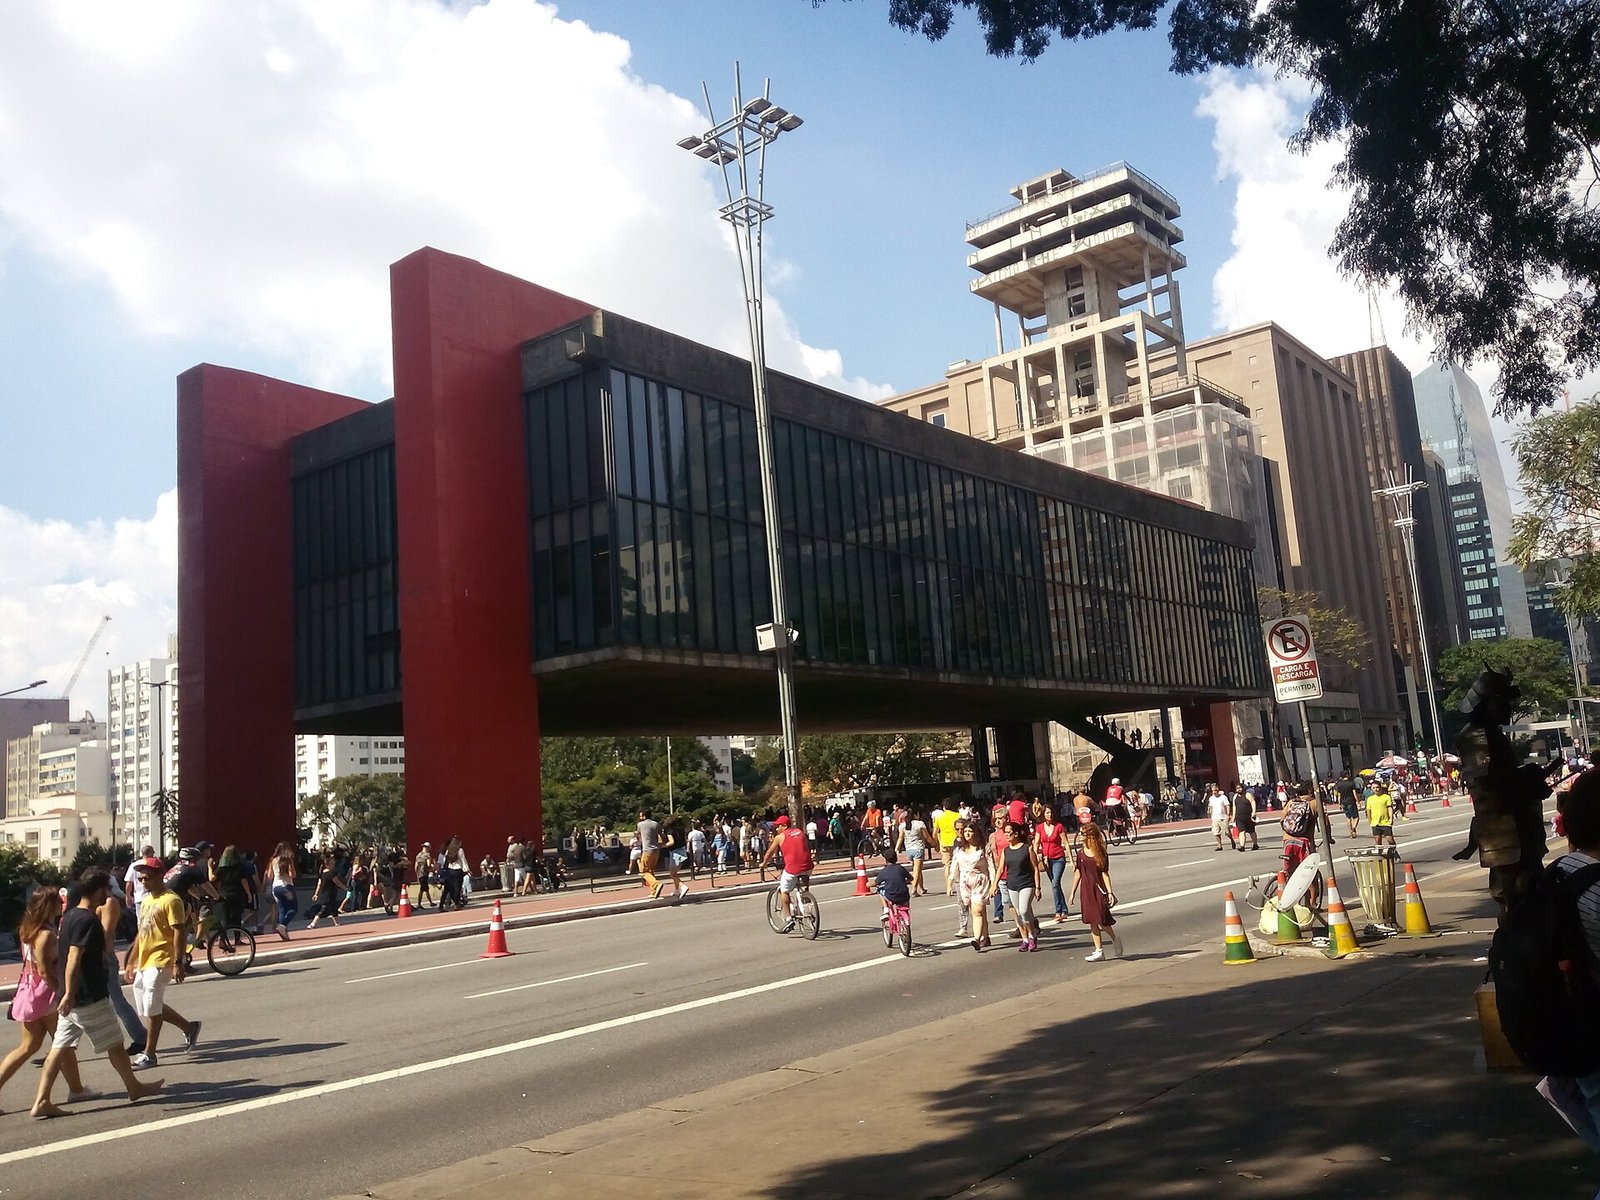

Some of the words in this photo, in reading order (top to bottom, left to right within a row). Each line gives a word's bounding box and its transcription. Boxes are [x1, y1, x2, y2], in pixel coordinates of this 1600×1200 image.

[1279, 664, 1303, 674] CARGA
[1303, 662, 1310, 670] E
[1277, 669, 1314, 681] DESCARGA
[1279, 683, 1317, 694] PERMITIDA
